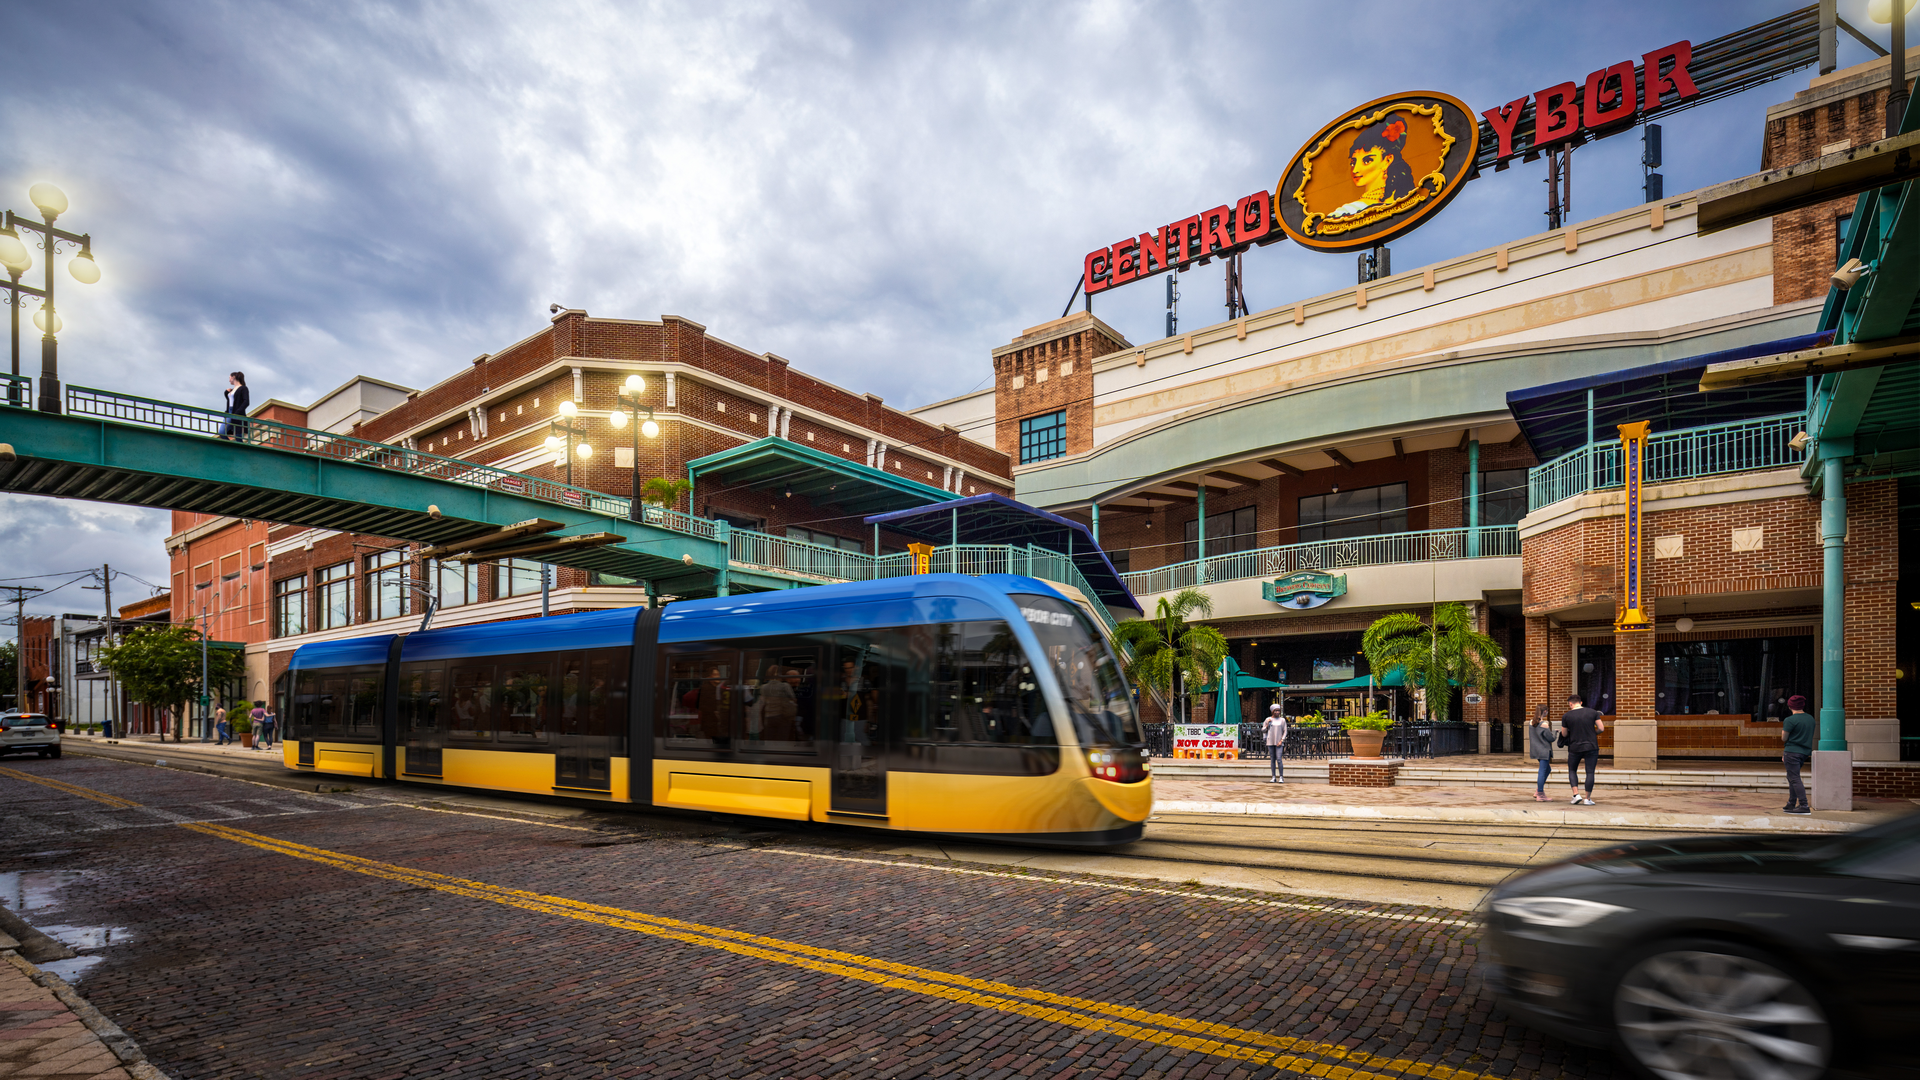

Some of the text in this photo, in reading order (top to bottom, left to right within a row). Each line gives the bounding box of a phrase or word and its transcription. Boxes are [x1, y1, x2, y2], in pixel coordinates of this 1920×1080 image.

[1084, 39, 1701, 293] CENTRO YBOR
[503, 477, 522, 487] DANGER
[564, 490, 581, 499] DANGER
[1050, 612, 1075, 627] CITY
[1187, 728, 1201, 736] TBBC
[1177, 739, 1234, 748] NOW OPEN
